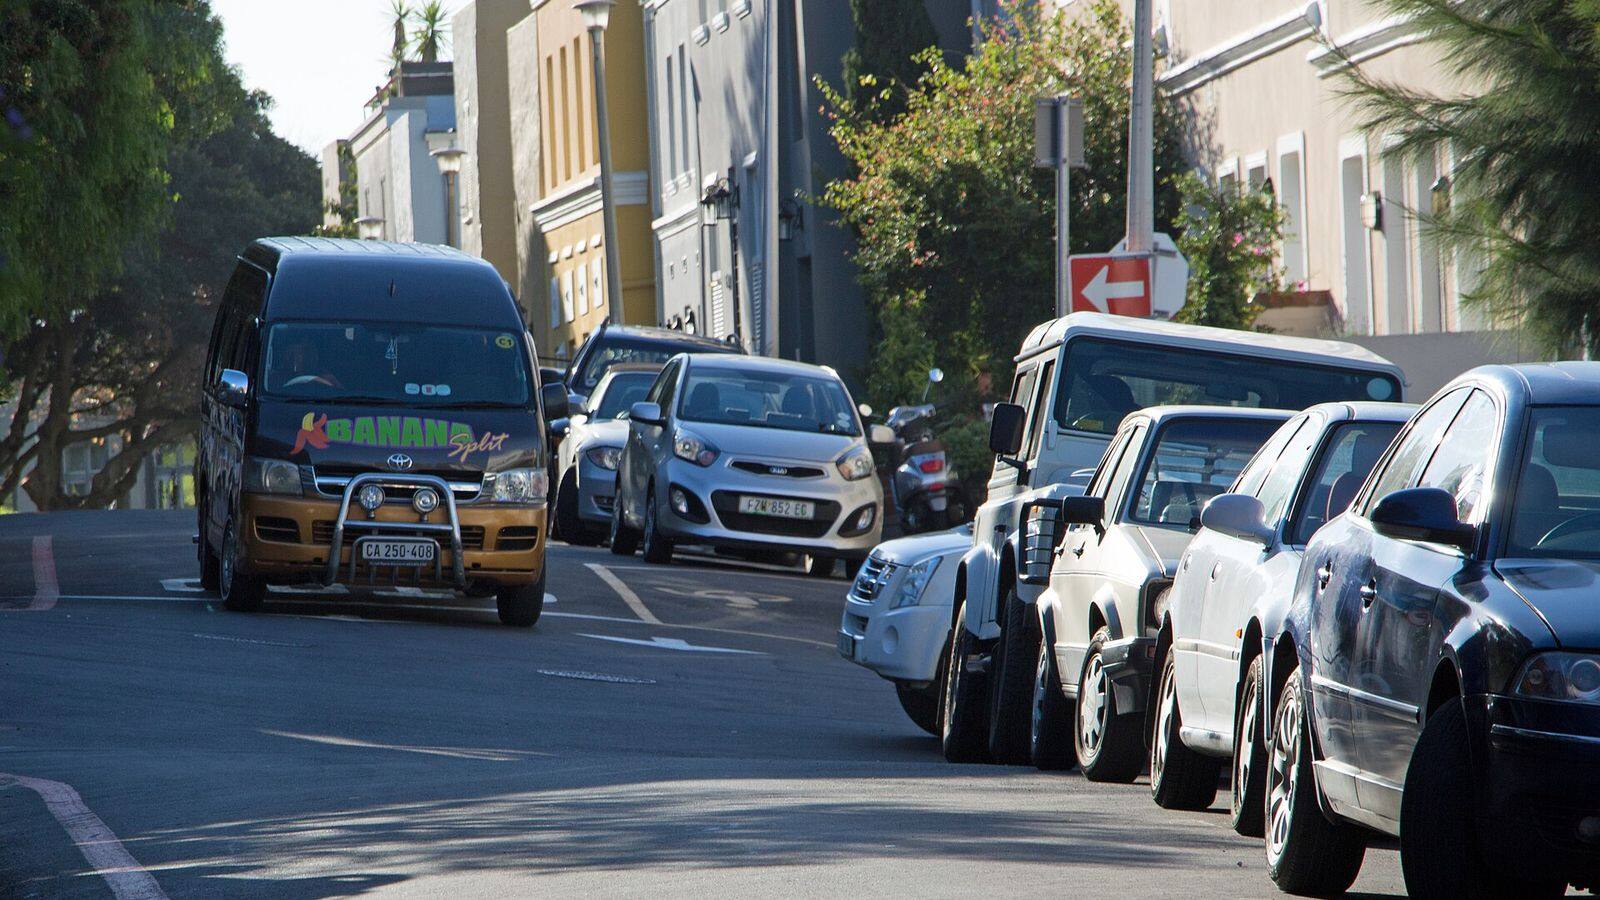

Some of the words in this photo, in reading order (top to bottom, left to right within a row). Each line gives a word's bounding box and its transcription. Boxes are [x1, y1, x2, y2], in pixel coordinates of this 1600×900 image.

[326, 416, 474, 448] BANANA
[448, 432, 509, 462] Split
[771, 501, 790, 515] 852
[366, 544, 380, 557] CA
